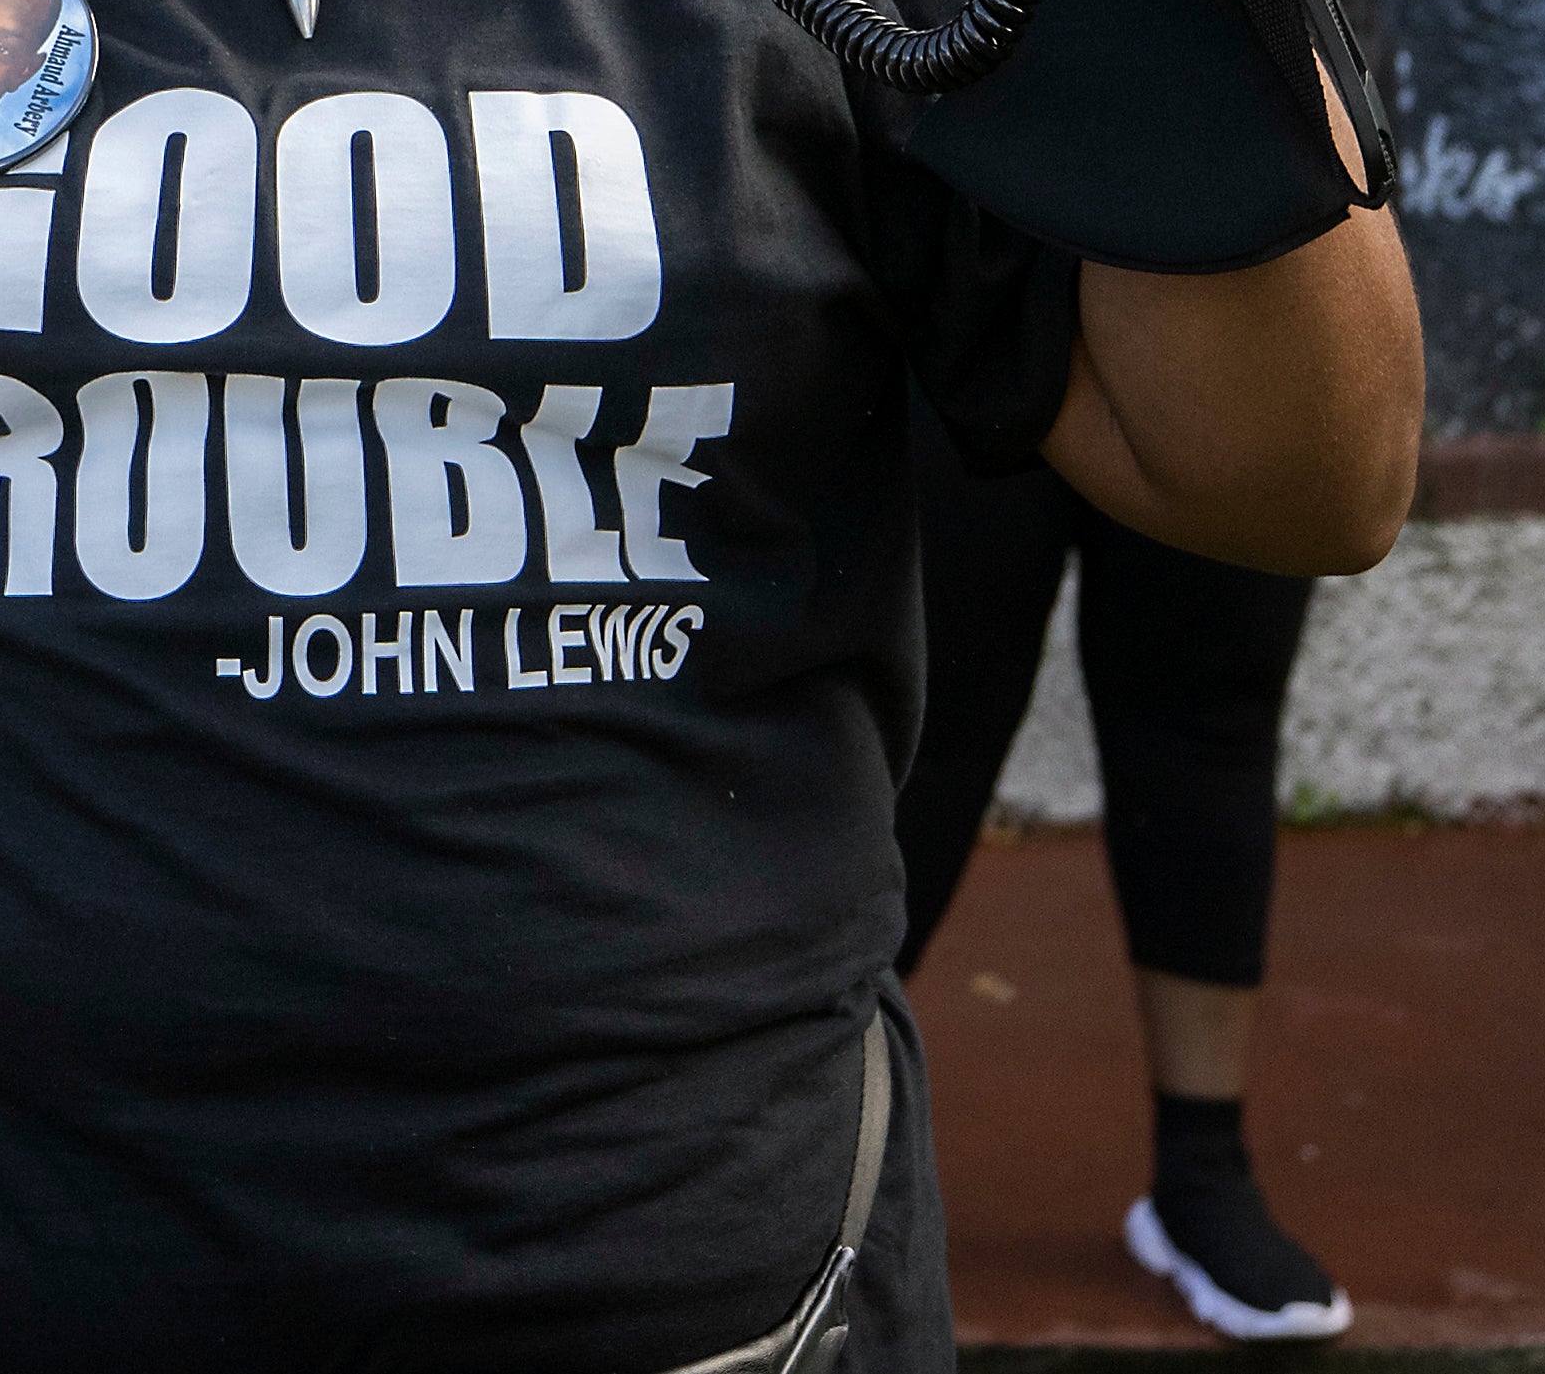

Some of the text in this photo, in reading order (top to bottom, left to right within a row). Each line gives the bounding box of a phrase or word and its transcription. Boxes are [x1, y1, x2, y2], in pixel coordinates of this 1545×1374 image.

[14, 24, 86, 138] Ahmaud Arbery
[215, 604, 704, 699] -JOHN LEWIS
